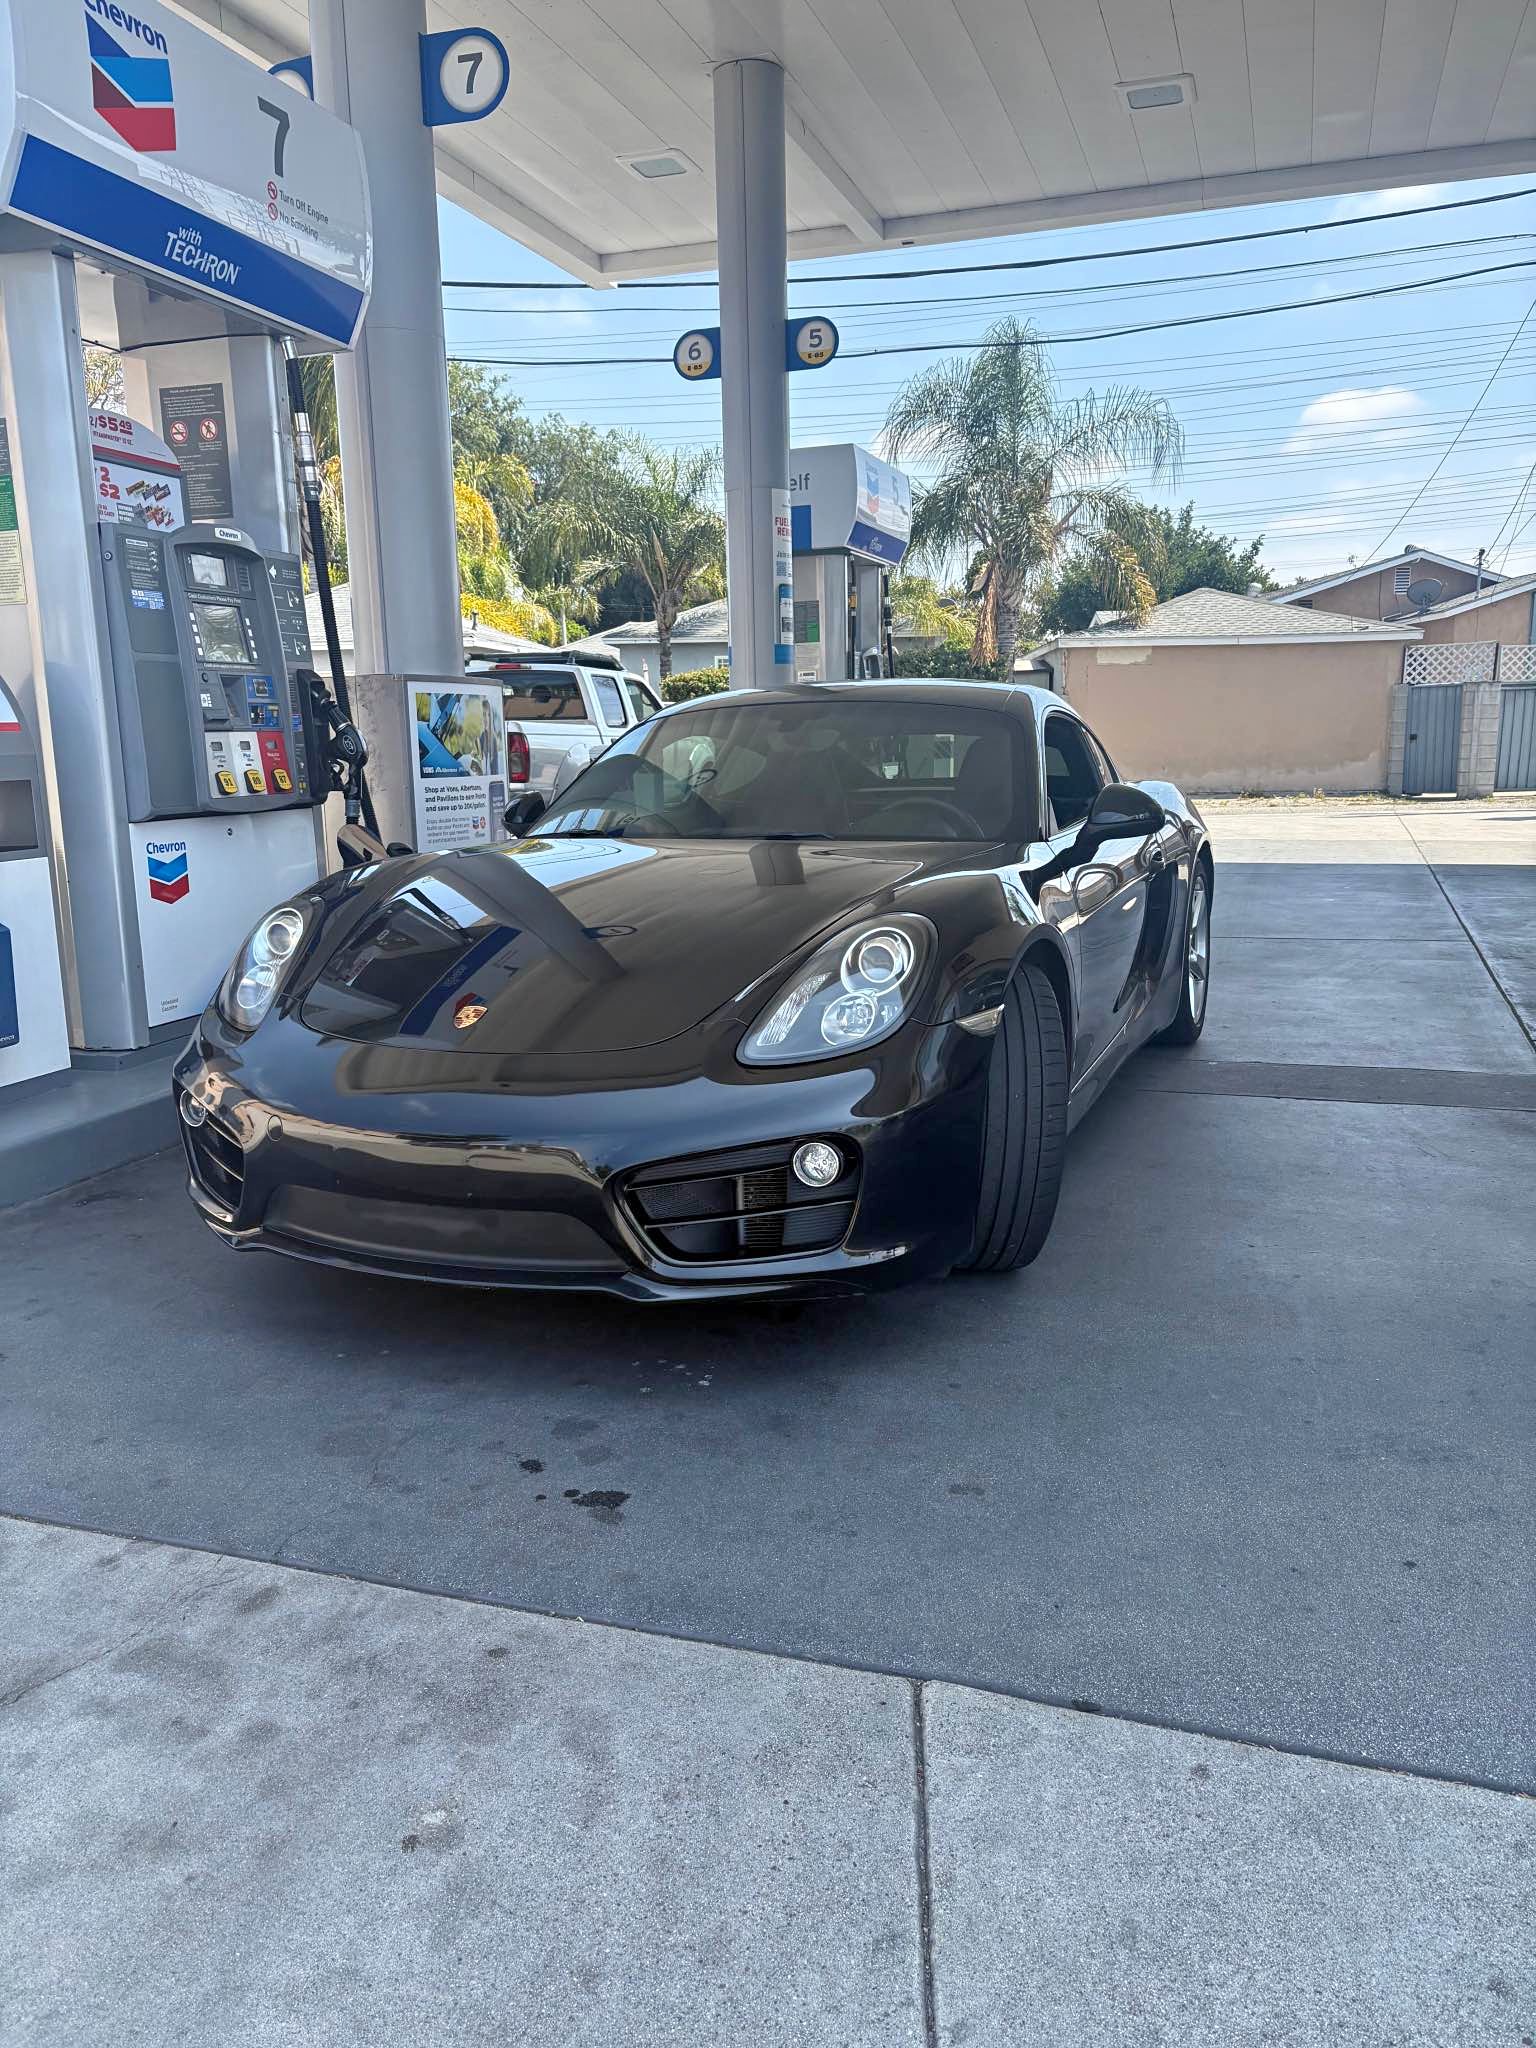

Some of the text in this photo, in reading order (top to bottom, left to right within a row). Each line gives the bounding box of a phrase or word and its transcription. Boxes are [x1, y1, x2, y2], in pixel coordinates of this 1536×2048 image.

[457, 52, 483, 95] 7
[257, 96, 290, 178] 7
[279, 189, 329, 226] Turn Off Engine
[178, 226, 202, 246] with
[279, 211, 320, 241] No Smoking
[163, 231, 240, 286] TECHRON
[808, 328, 823, 348] 5
[688, 341, 702, 361] 6
[100, 483, 120, 500] $2
[790, 473, 811, 491] elf
[424, 786, 439, 794] Shop
[146, 841, 187, 855] Chevron
